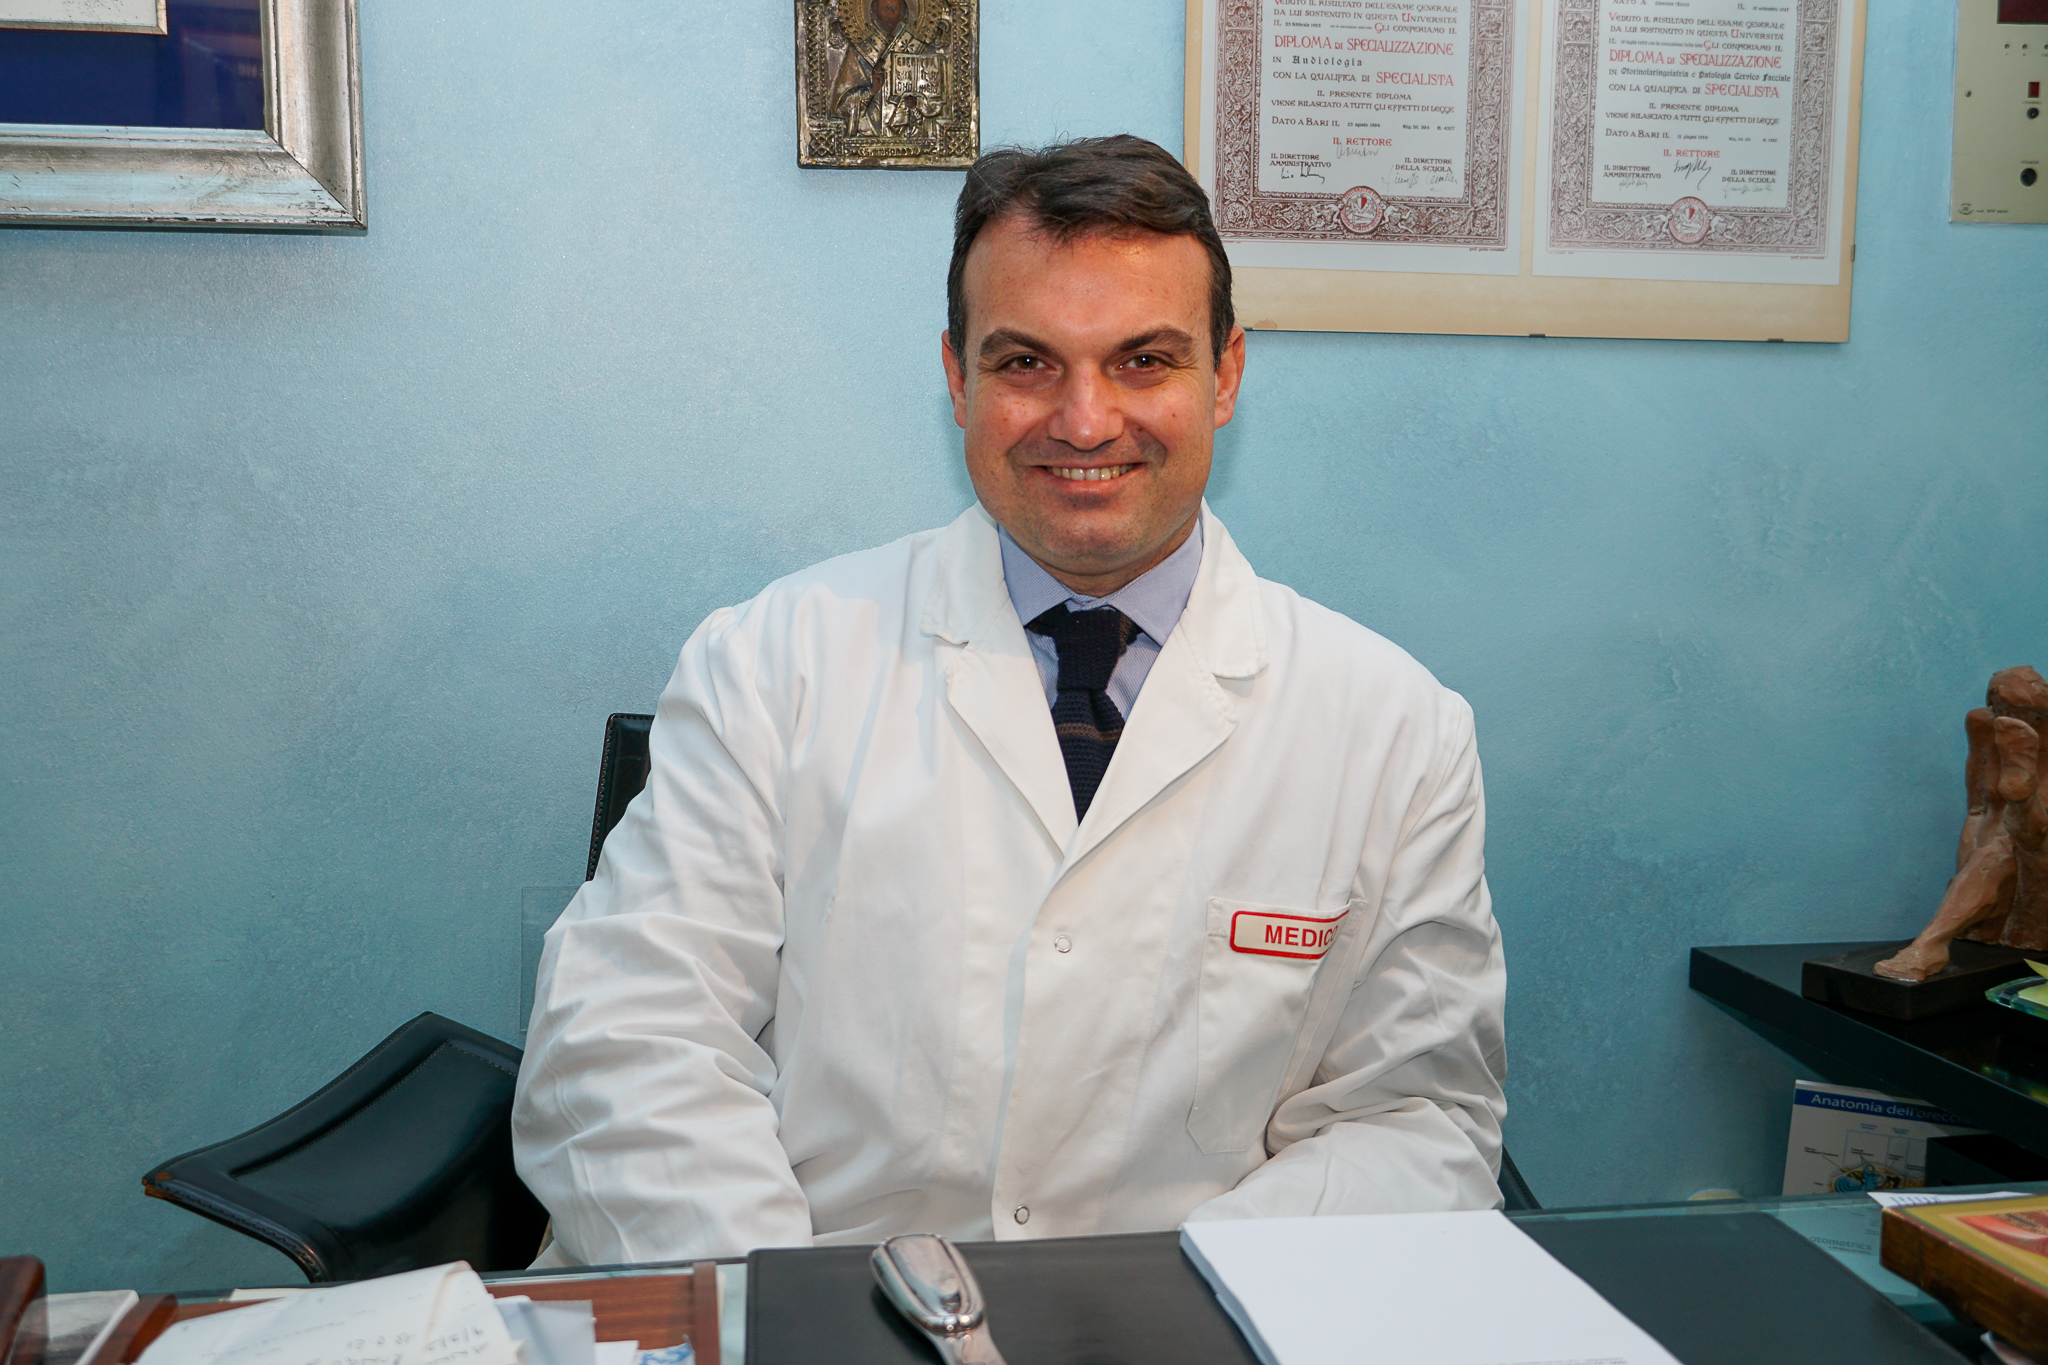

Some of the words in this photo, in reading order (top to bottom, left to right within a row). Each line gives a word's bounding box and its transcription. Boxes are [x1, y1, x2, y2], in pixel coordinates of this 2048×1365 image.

[1365, 2, 1414, 10] DELL'ESAME
[1305, 10, 1351, 18] SOSTENUTO
[1609, 12, 1641, 22] VEDUTO
[1653, 16, 1694, 24] RISULTATO
[1697, 19, 1743, 27] DELL'ESAME
[1746, 21, 1784, 29] GENERALE
[1375, 22, 1390, 34] GLI
[1393, 25, 1445, 34] CONFERIAMO
[1640, 27, 1683, 35] SOSTENUTO
[1274, 35, 1332, 50] DIPLOMA
[1347, 37, 1454, 56] SPECIALIZZAZIONE
[1703, 40, 1719, 51] GLI
[1722, 43, 1771, 51] CONFERIAMO
[1292, 55, 1362, 68] Audiologia
[1609, 49, 1664, 64] DIPLOMA
[1680, 53, 1781, 69] SPECIALIZZAZIONE
[1310, 73, 1356, 83] QUALIFICA
[1376, 72, 1454, 86] SPECIALISTA
[1699, 71, 1731, 80] Patologia
[1734, 72, 1759, 80] Cervico
[1762, 74, 1791, 82] Facciale
[1644, 85, 1687, 95] QUALIFICA
[1704, 84, 1780, 98] SPECIALISTA
[1430, 106, 1454, 114] LEGGE
[1271, 116, 1296, 125] DATO
[1306, 117, 1328, 126] BARI
[1605, 128, 1628, 137] DATO
[1638, 130, 1659, 138] BARI
[1346, 138, 1392, 146] RETTORE
[1676, 149, 1720, 158] RETTORE
[1810, 1094, 1882, 1113] Anatomia
[1810, 1236, 1871, 1250] otometrics
